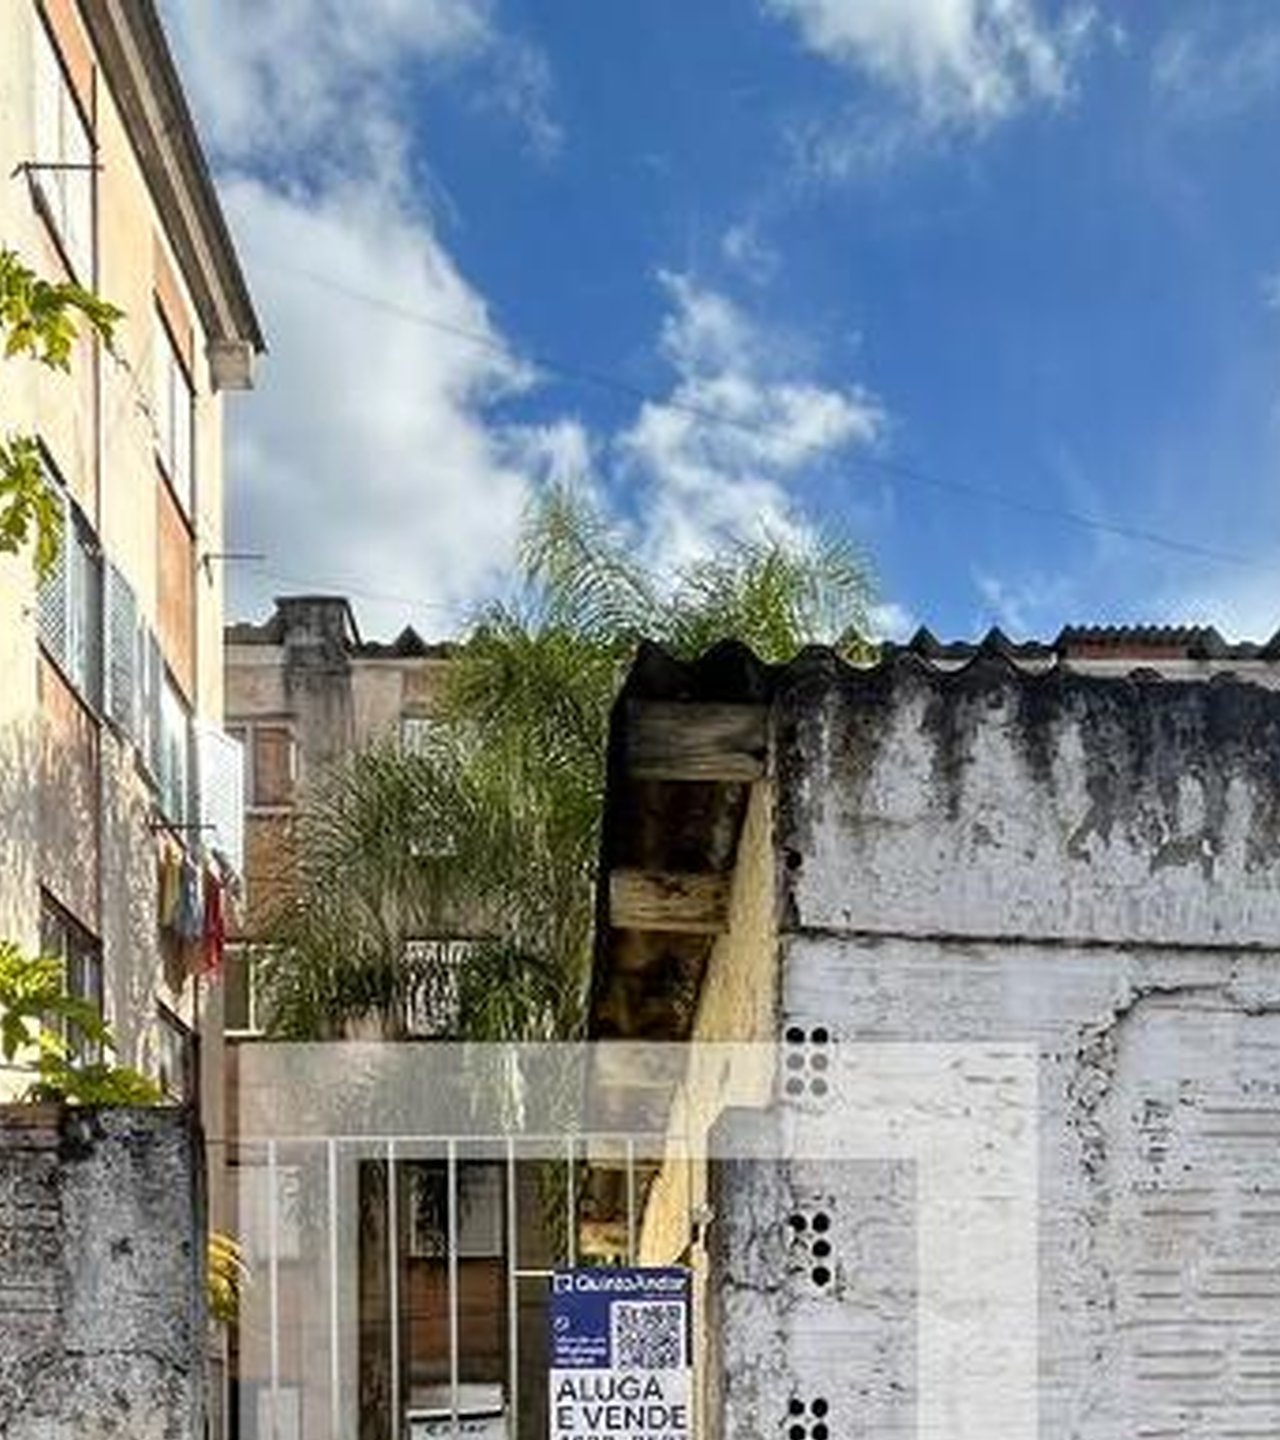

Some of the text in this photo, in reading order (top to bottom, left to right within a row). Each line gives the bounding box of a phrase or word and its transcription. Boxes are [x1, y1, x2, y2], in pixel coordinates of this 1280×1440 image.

[556, 1374, 664, 1402] ALUGA
[557, 1404, 687, 1430] E VENDE
